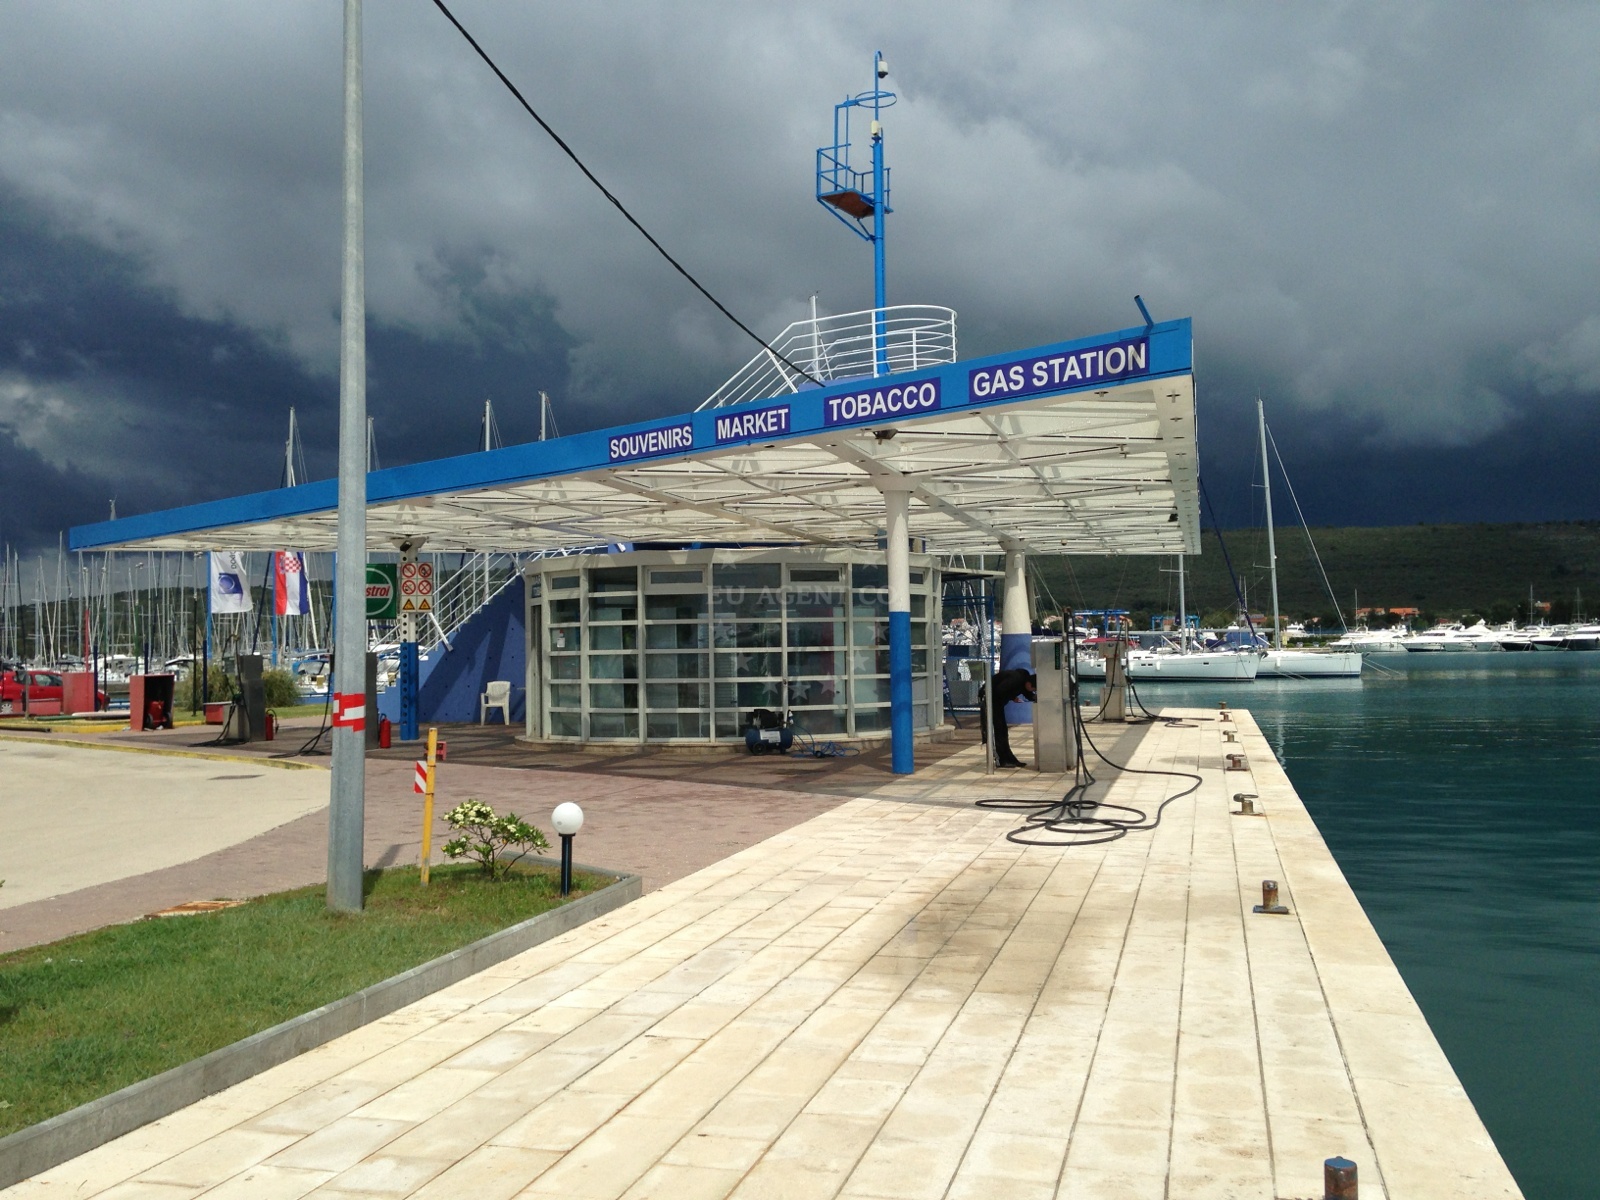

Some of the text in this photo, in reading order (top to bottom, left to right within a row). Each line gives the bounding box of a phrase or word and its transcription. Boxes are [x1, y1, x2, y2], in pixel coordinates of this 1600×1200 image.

[973, 343, 1146, 397] GAS STATION
[828, 382, 936, 421] TOBACCO
[717, 409, 789, 440] MARKET
[610, 425, 693, 459] SOUVENIRS
[365, 585, 390, 597] strol
